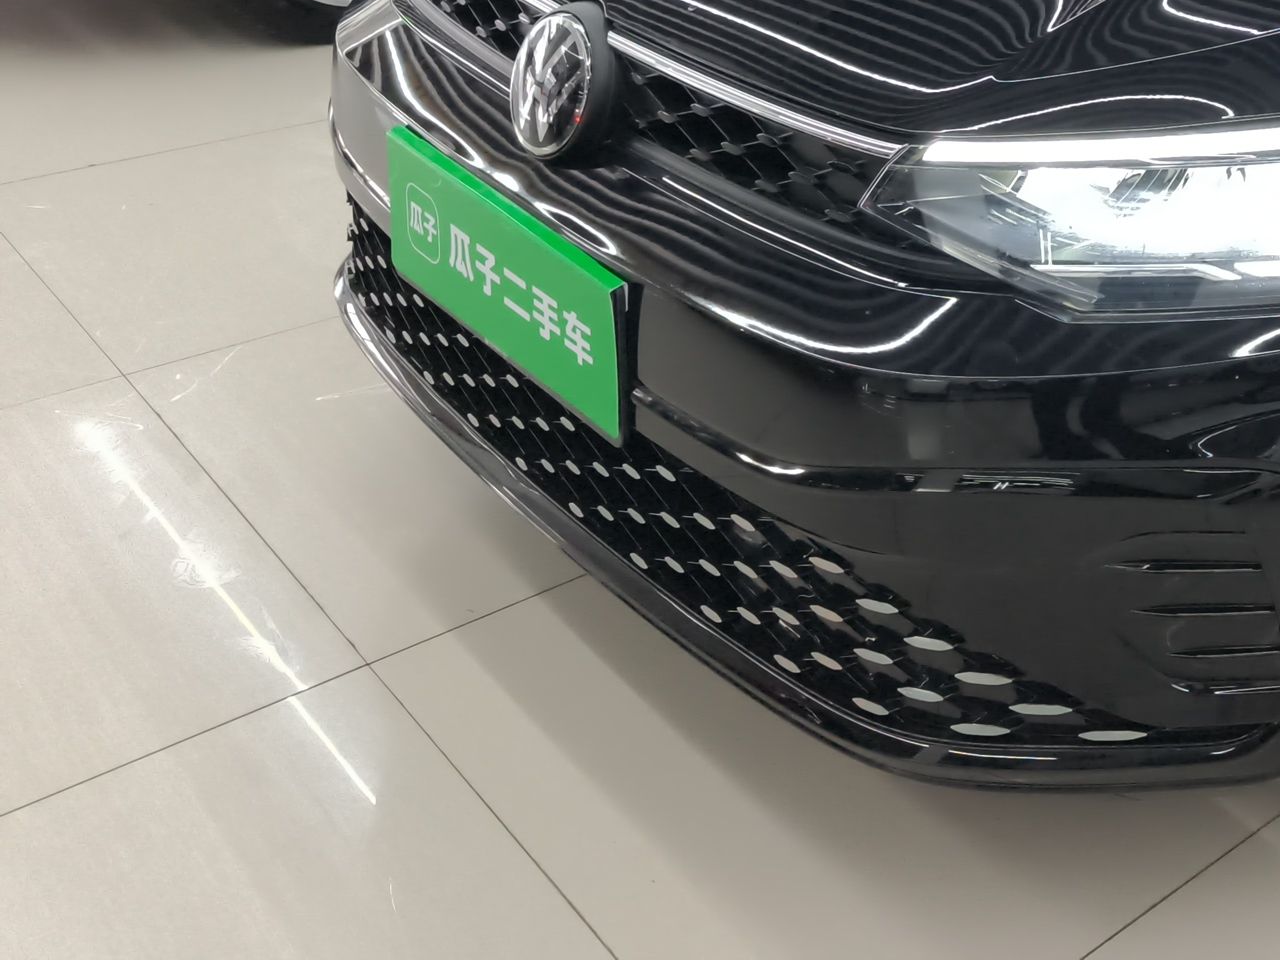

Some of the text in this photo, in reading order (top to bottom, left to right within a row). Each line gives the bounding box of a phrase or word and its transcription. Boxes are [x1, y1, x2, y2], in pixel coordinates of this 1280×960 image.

[410, 201, 437, 242] 瓜子
[449, 224, 593, 365] 瓜子二手车
